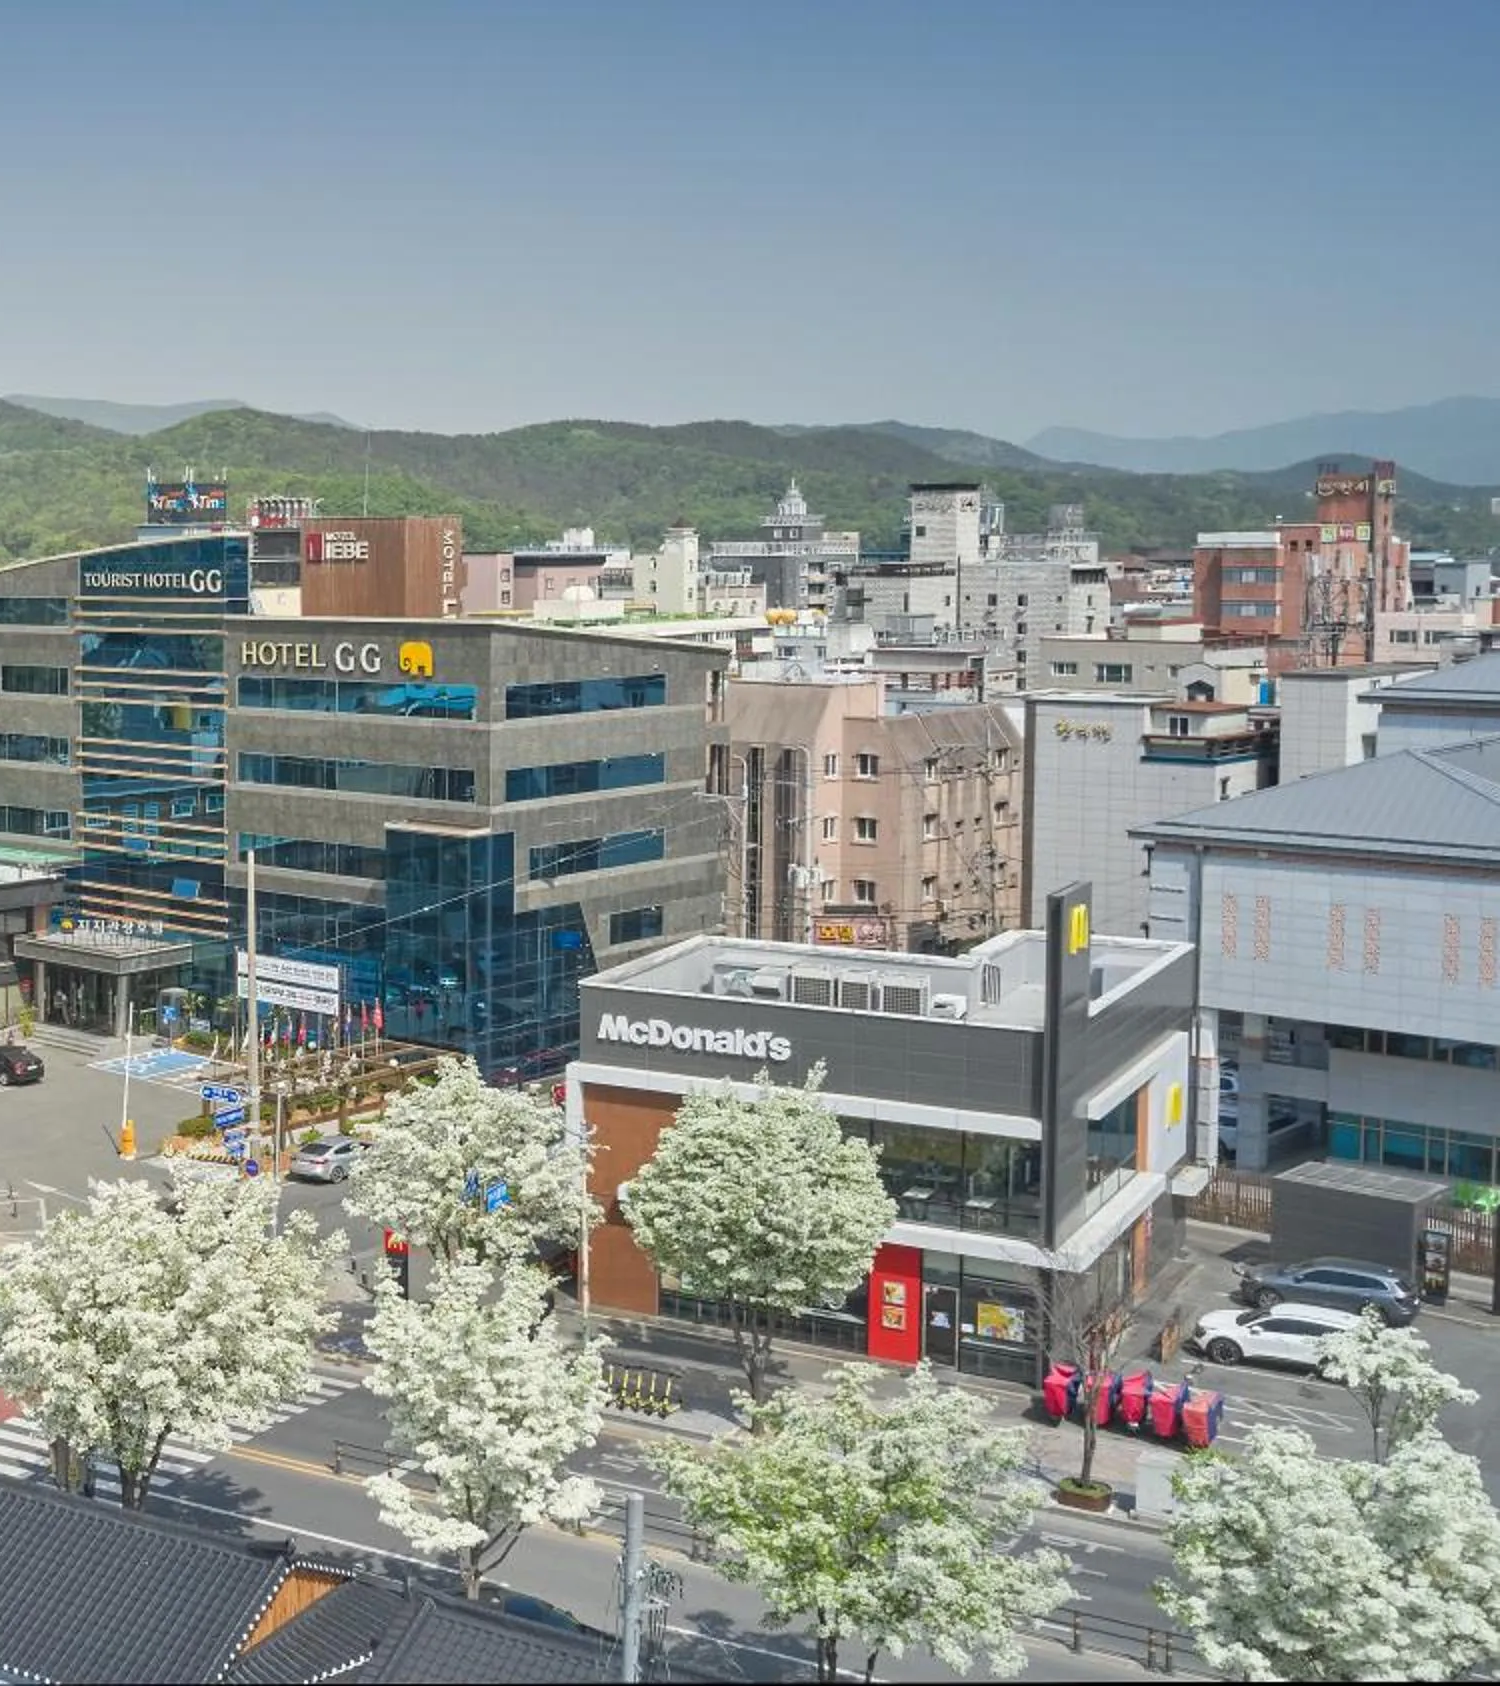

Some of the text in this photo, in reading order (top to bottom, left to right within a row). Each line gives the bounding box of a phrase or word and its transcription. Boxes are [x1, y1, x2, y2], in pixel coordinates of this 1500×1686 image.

[84, 569, 222, 593] TOURIST HOTEL GG
[443, 529, 455, 594] MOTEL
[241, 641, 381, 673] HOTEL GG
[598, 1013, 792, 1061] McDonald's
